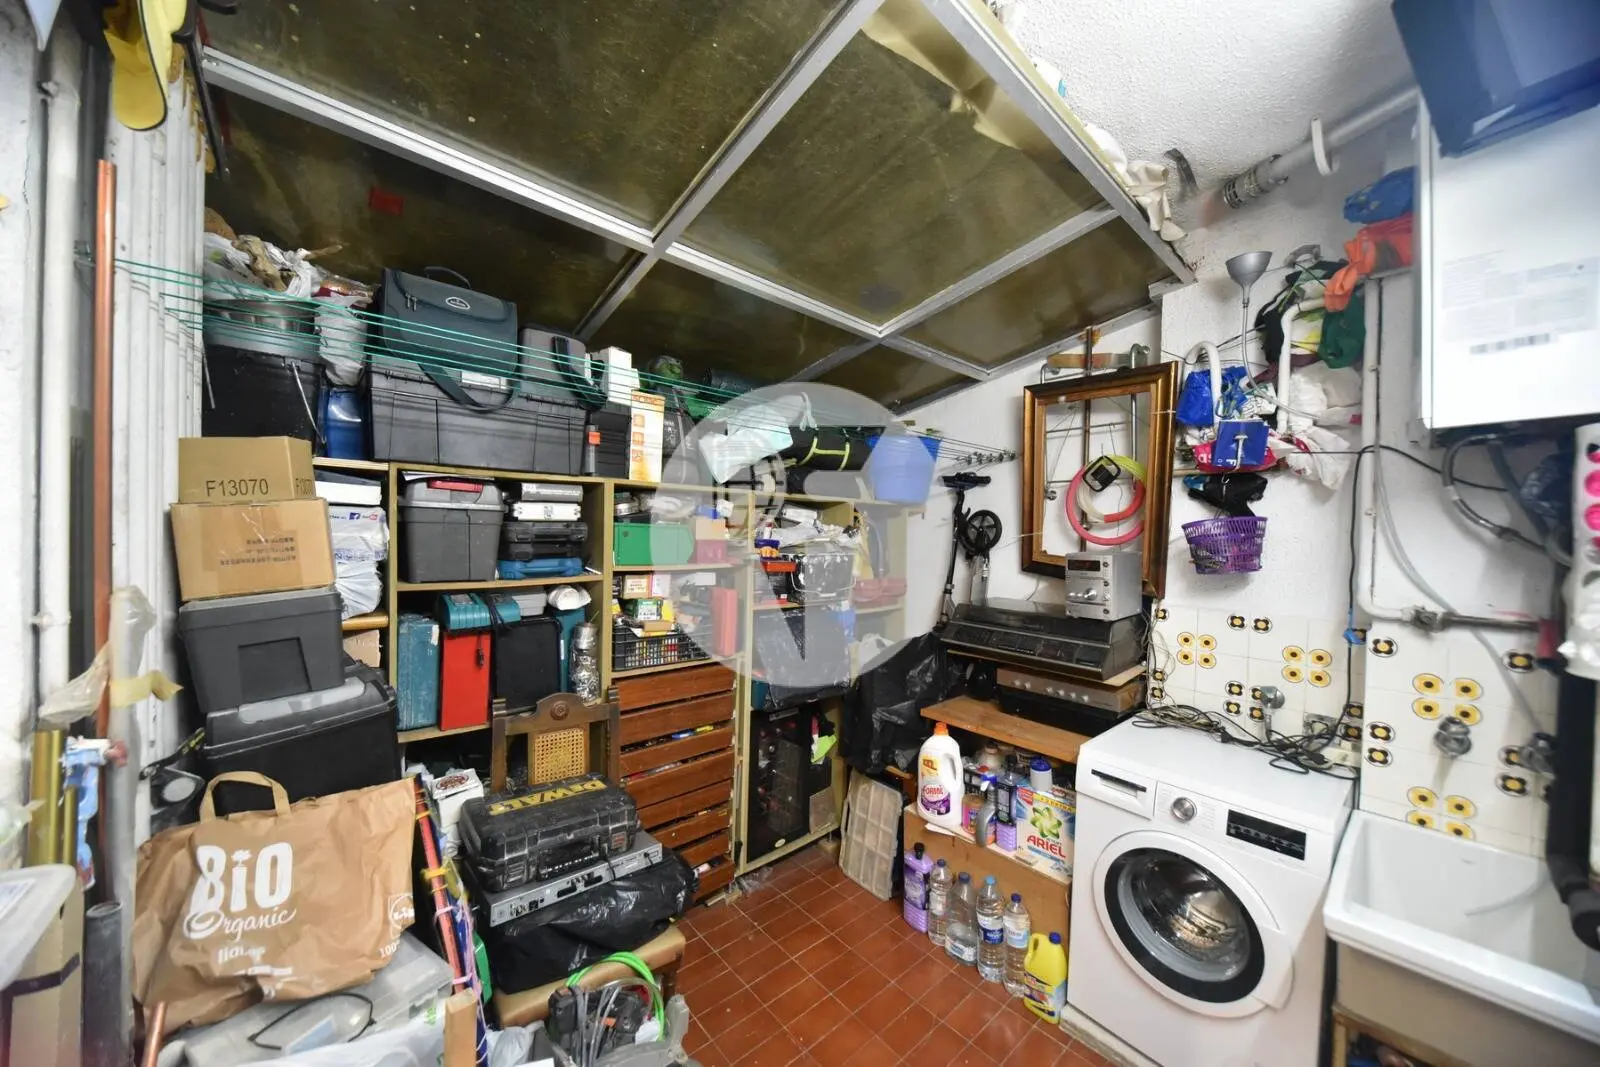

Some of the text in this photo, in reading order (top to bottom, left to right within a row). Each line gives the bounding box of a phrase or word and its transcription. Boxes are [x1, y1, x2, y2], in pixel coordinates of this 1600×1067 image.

[206, 478, 269, 497] F13070
[1027, 835, 1067, 859] ARIEL
[183, 907, 297, 942] Organic
